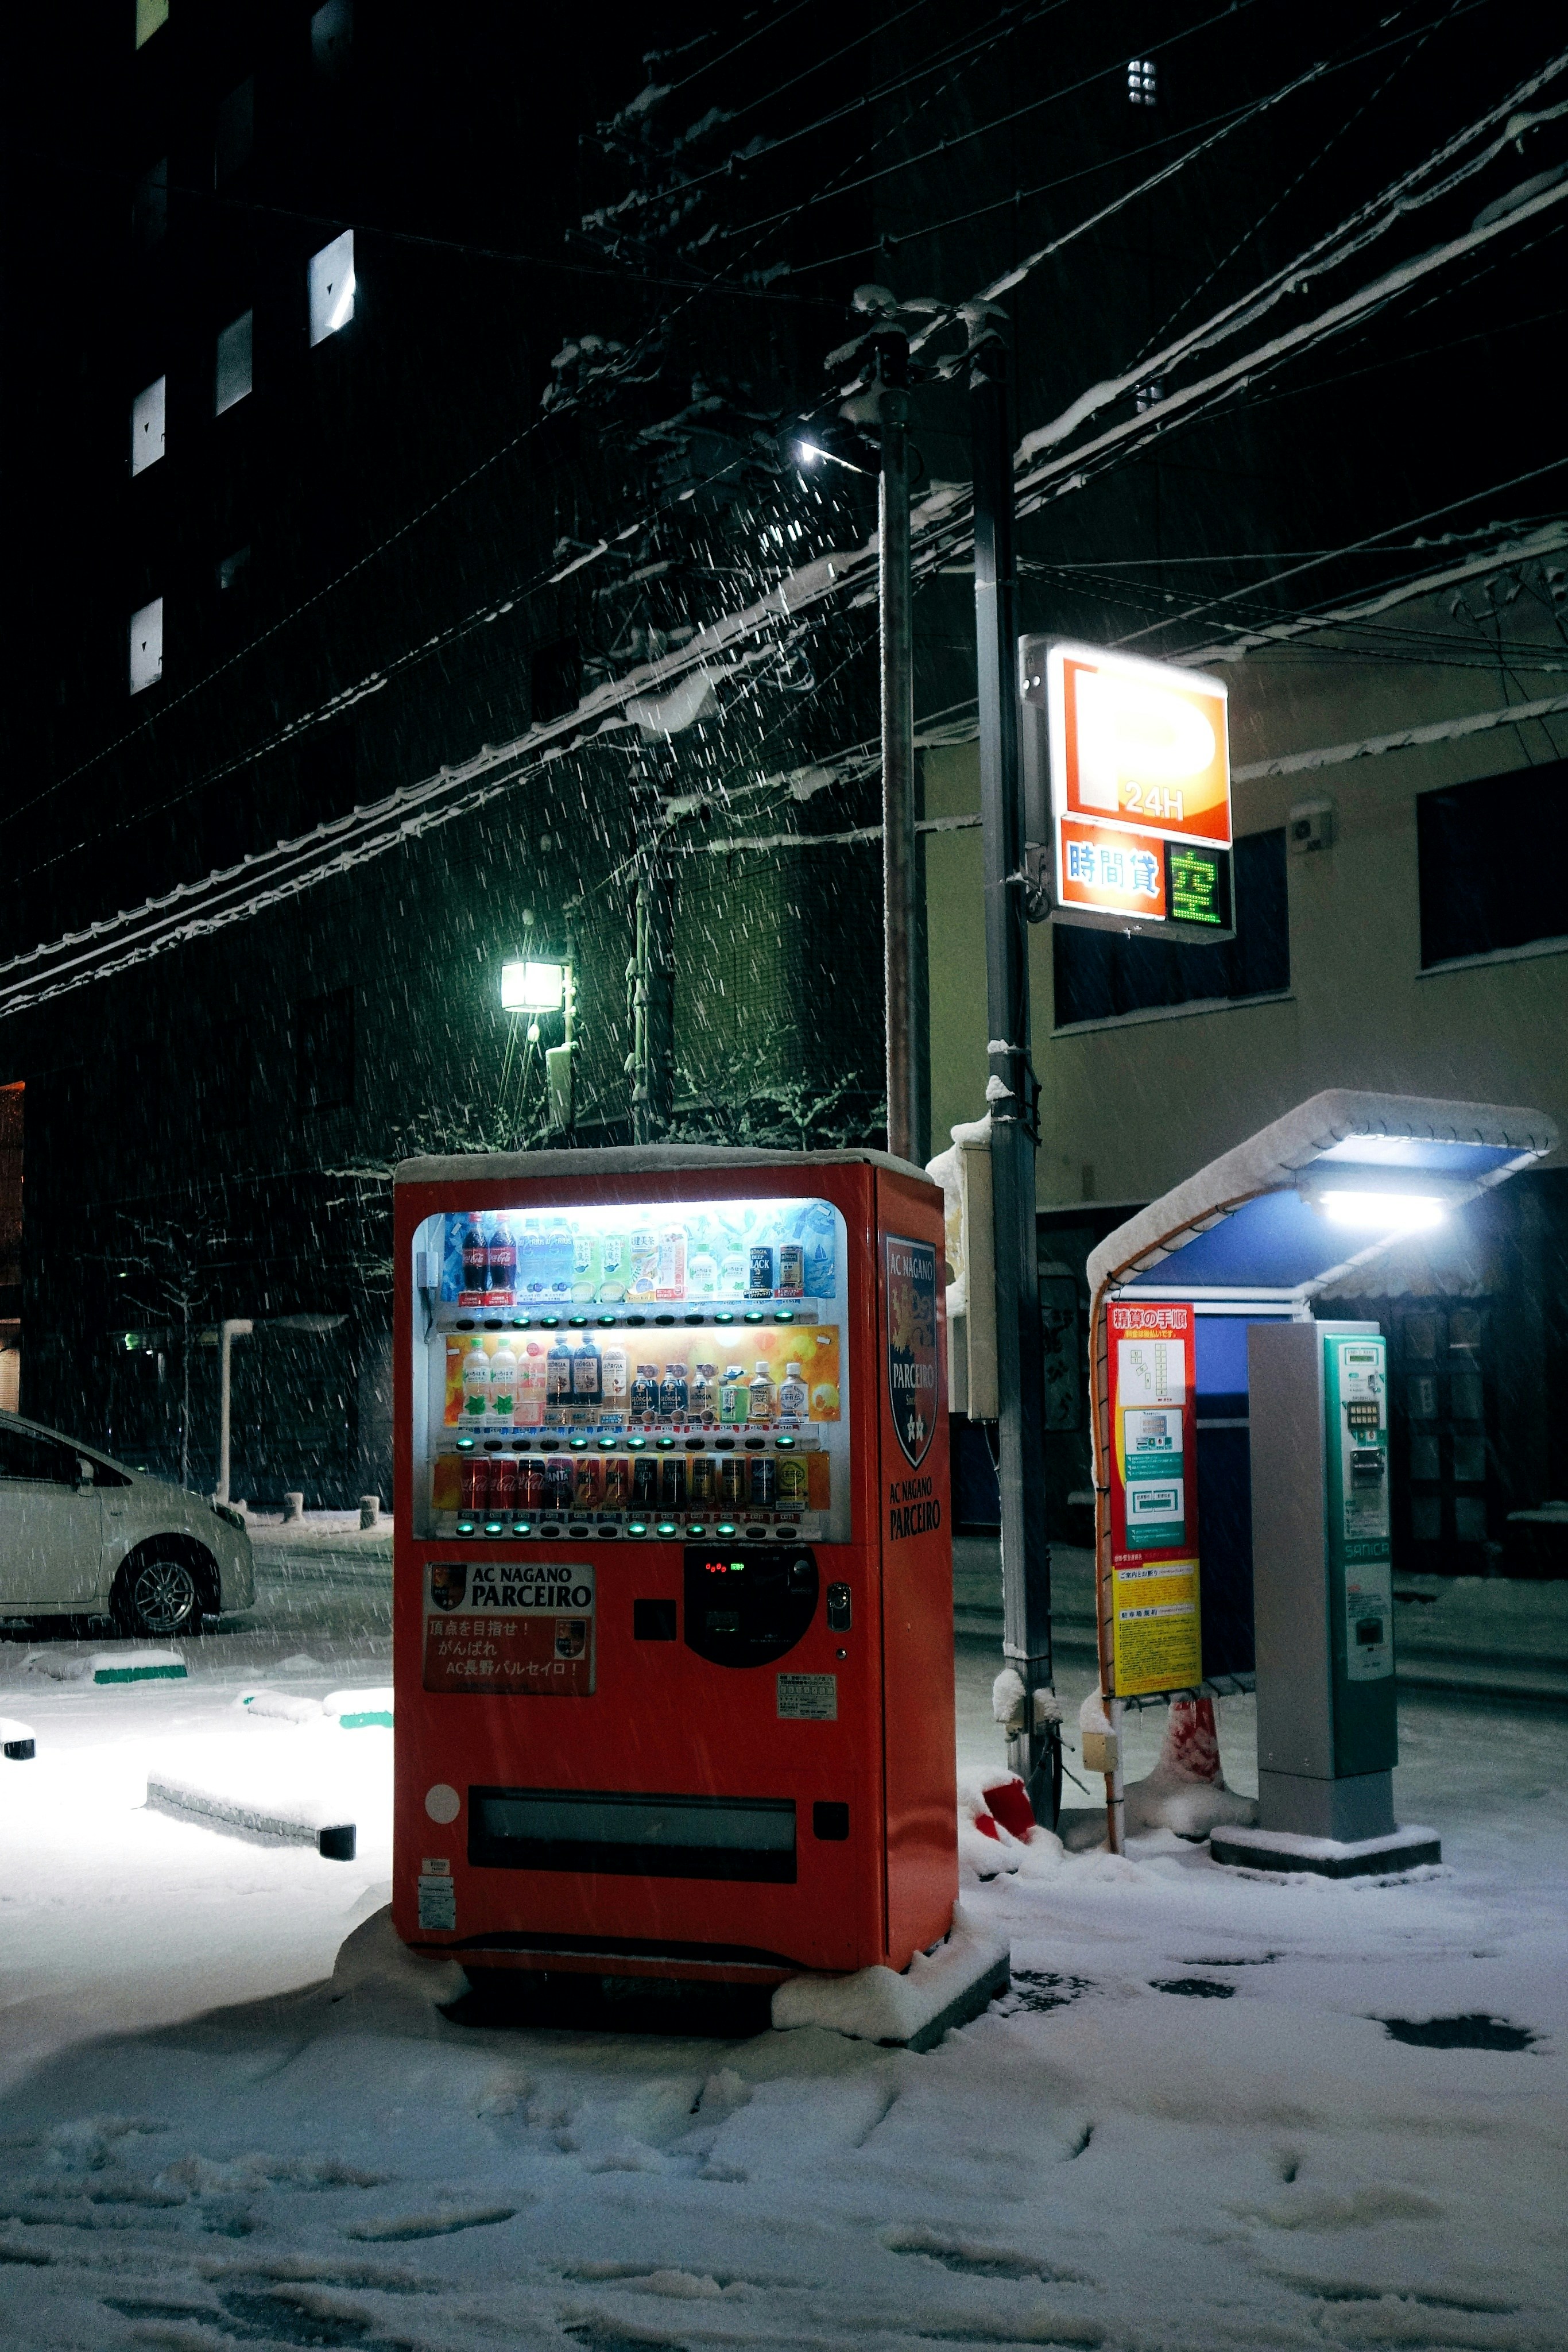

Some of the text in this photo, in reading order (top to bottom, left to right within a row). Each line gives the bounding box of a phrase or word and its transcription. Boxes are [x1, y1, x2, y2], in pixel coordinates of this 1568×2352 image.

[1075, 669, 1215, 811] P
[1125, 780, 1184, 821] 24H
[1068, 843, 1159, 896] 時間貸
[1170, 850, 1221, 923] 空
[751, 1259, 770, 1268] LACK
[891, 1254, 933, 1281] AC NAGANO
[1113, 1308, 1187, 1329] 精算の手順
[893, 1363, 934, 1389] PARCEIRO
[547, 1471, 568, 1483] ANTA
[635, 1472, 653, 1480] LACK
[664, 1473, 682, 1481] LACK
[890, 1476, 932, 1504] AC NAGANO
[890, 1499, 940, 1541] PARCEIRO
[1345, 1543, 1389, 1558] SANICA
[472, 1568, 572, 1583] AC NAGANO
[471, 1585, 591, 1608] PARCEIRO
[429, 1620, 529, 1637] 頂点を目指せ！
[438, 1641, 498, 1657] がんばれ
[446, 1660, 578, 1676] AC長野パルセイロ！
